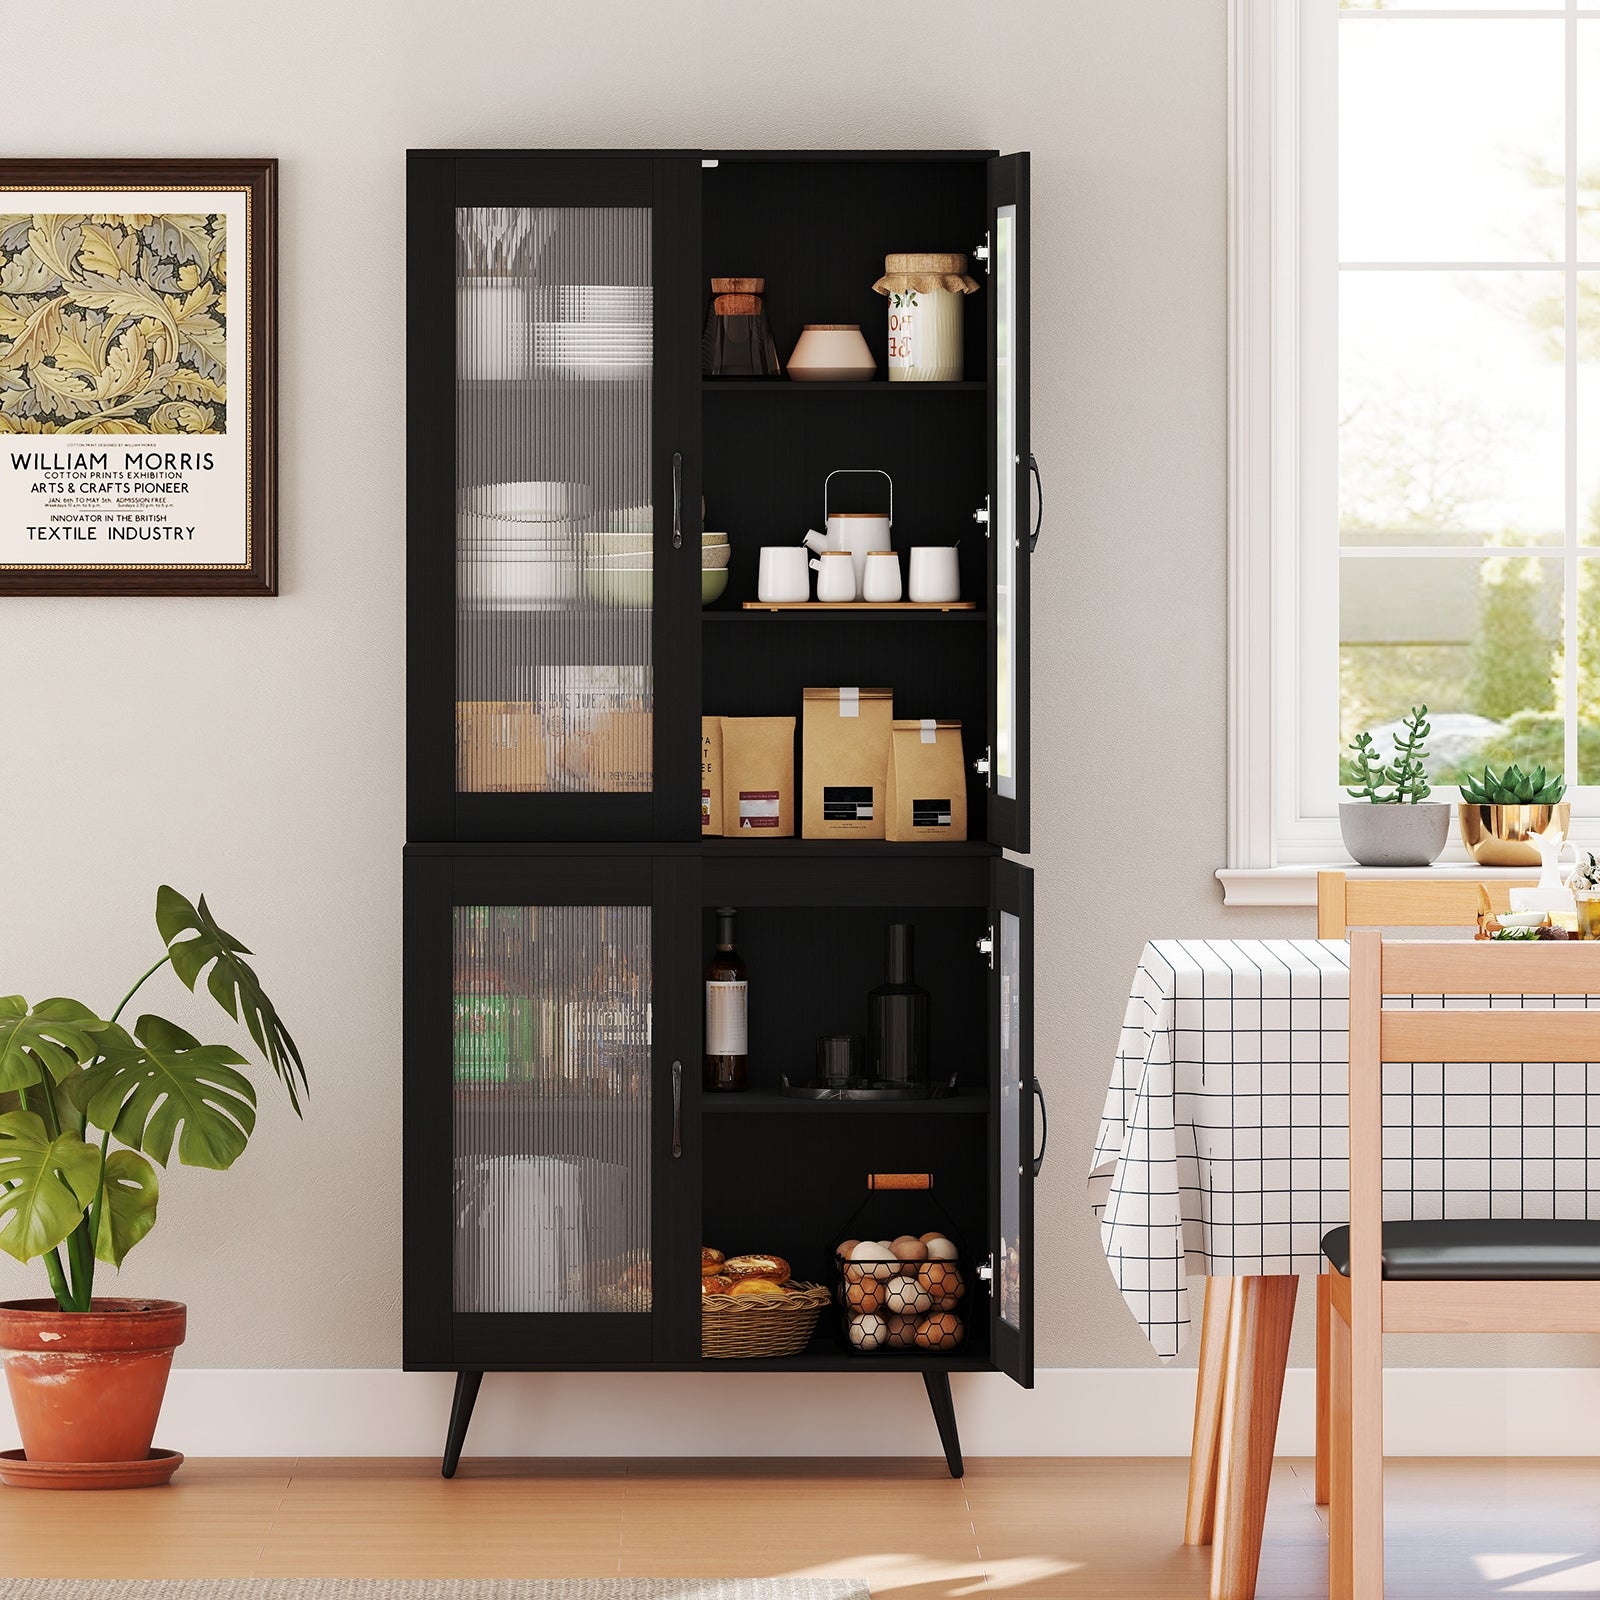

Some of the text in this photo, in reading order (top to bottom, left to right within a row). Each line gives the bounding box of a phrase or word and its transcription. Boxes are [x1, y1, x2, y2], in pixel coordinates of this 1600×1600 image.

[11, 452, 214, 470] WILLIAM MORRIS
[44, 472, 182, 480] COTTON PRINTS EXHIBITION
[31, 482, 189, 494] ARTS & CRAFTS PIONEER
[26, 526, 196, 540] TEXTILE INDUSTRY
